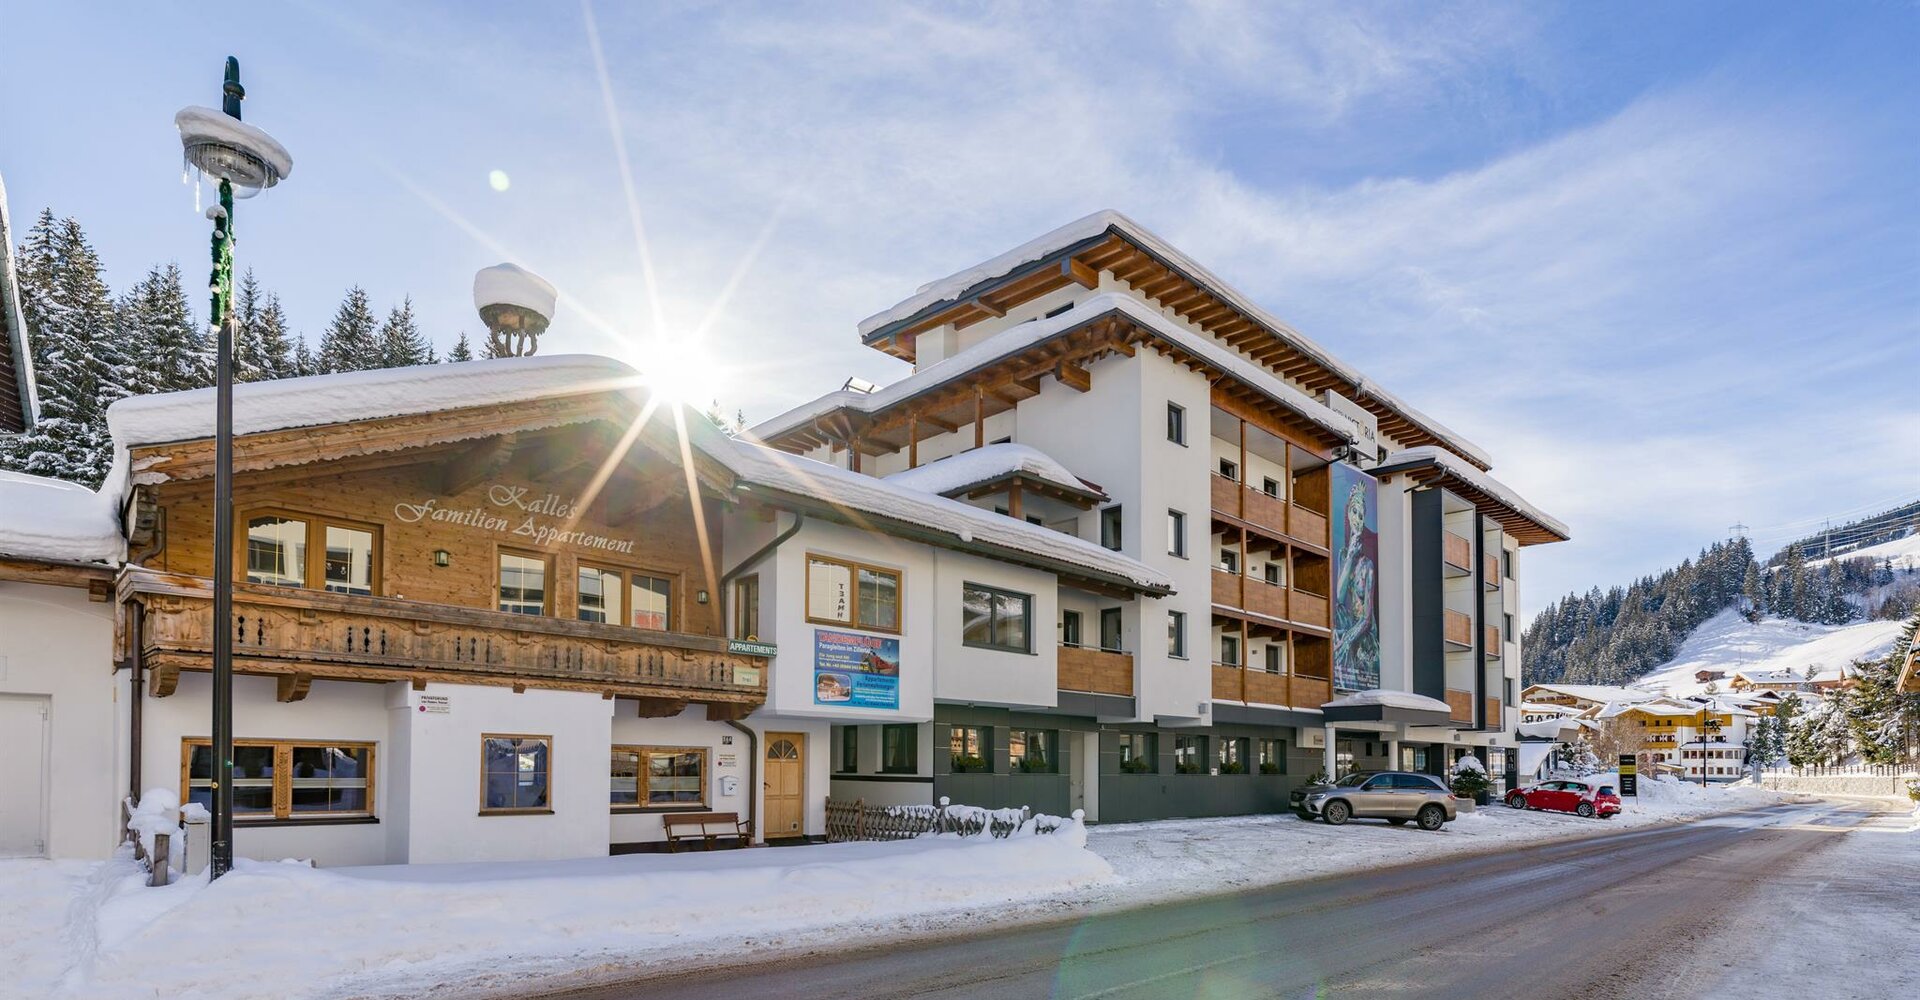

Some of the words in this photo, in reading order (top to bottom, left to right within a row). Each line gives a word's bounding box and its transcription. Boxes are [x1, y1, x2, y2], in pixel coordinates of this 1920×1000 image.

[489, 485, 579, 520] Kalle's
[394, 499, 509, 532] Familien
[512, 517, 635, 553] Appartement
[730, 642, 777, 655] APPARTEMENTS
